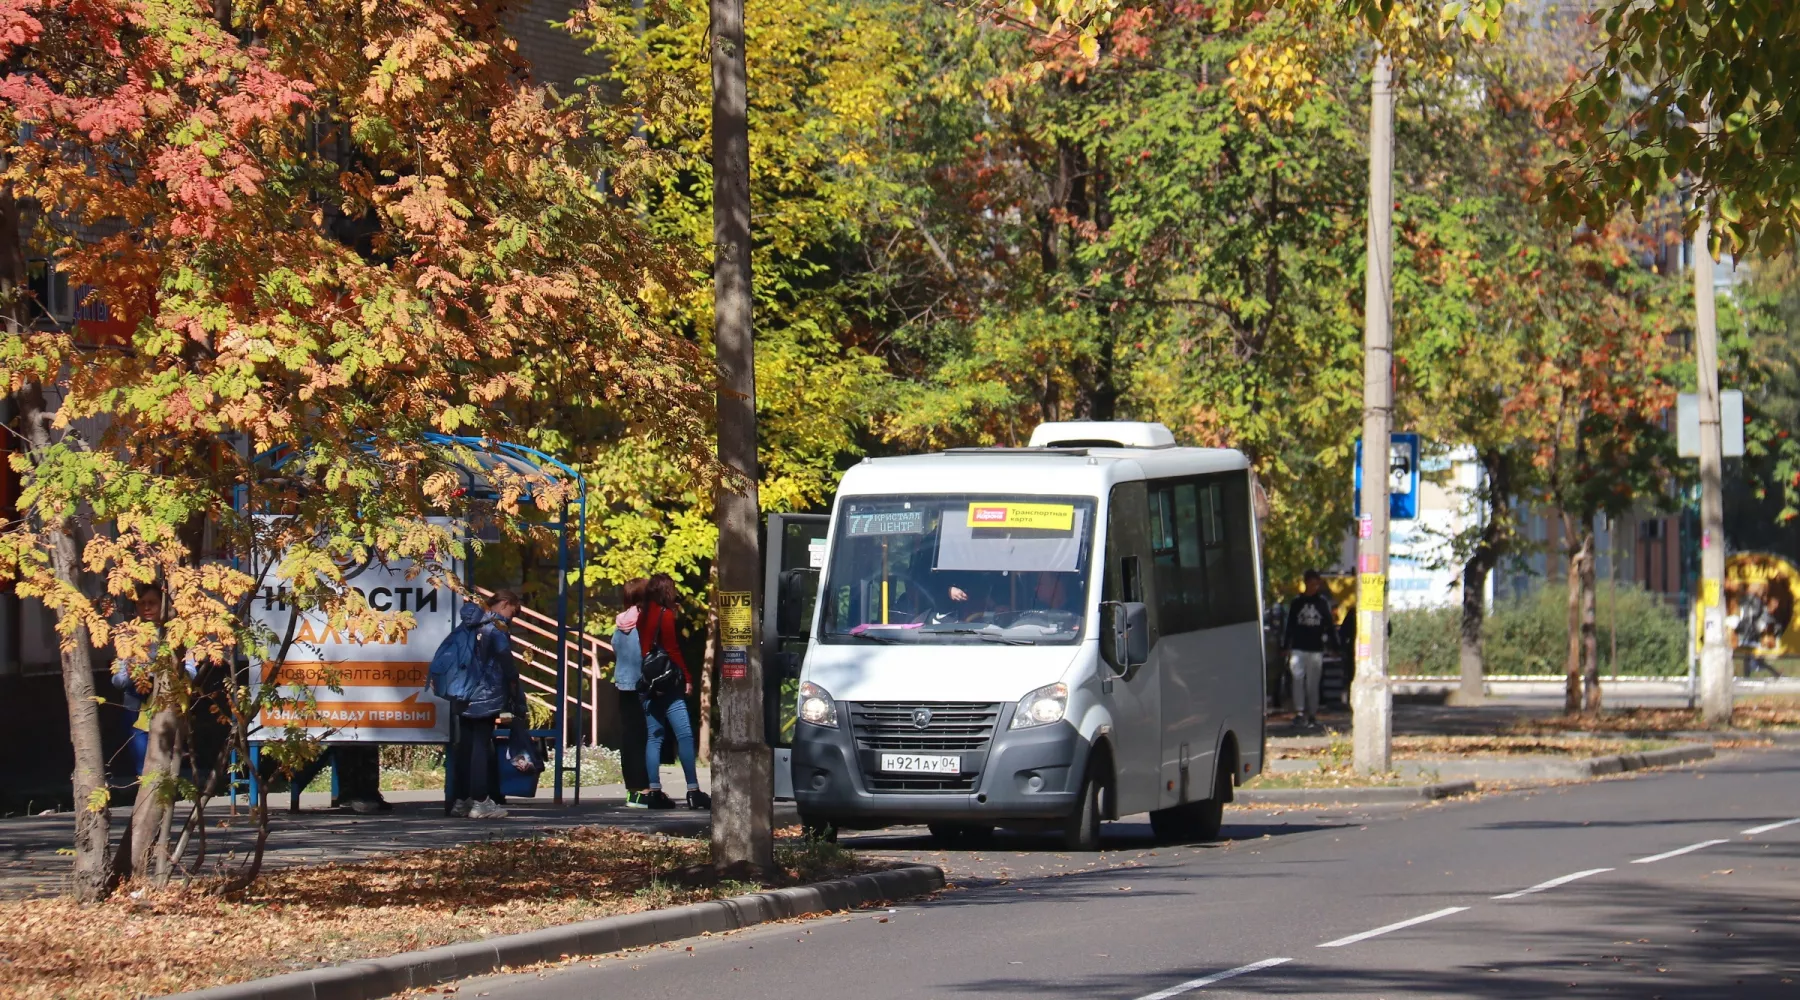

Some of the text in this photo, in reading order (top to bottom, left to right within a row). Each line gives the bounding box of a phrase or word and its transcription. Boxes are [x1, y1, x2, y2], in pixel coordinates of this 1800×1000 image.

[874, 513, 920, 521] КРИСТАЛЛ
[1011, 509, 1068, 517] Транспортная
[850, 515, 873, 533] 77
[880, 522, 914, 532] ЦЕНТР
[265, 587, 437, 612] НСТИ
[720, 596, 751, 607] ШУБ
[276, 666, 423, 683] новосиалтая.рф
[266, 710, 308, 720] УЗНА
